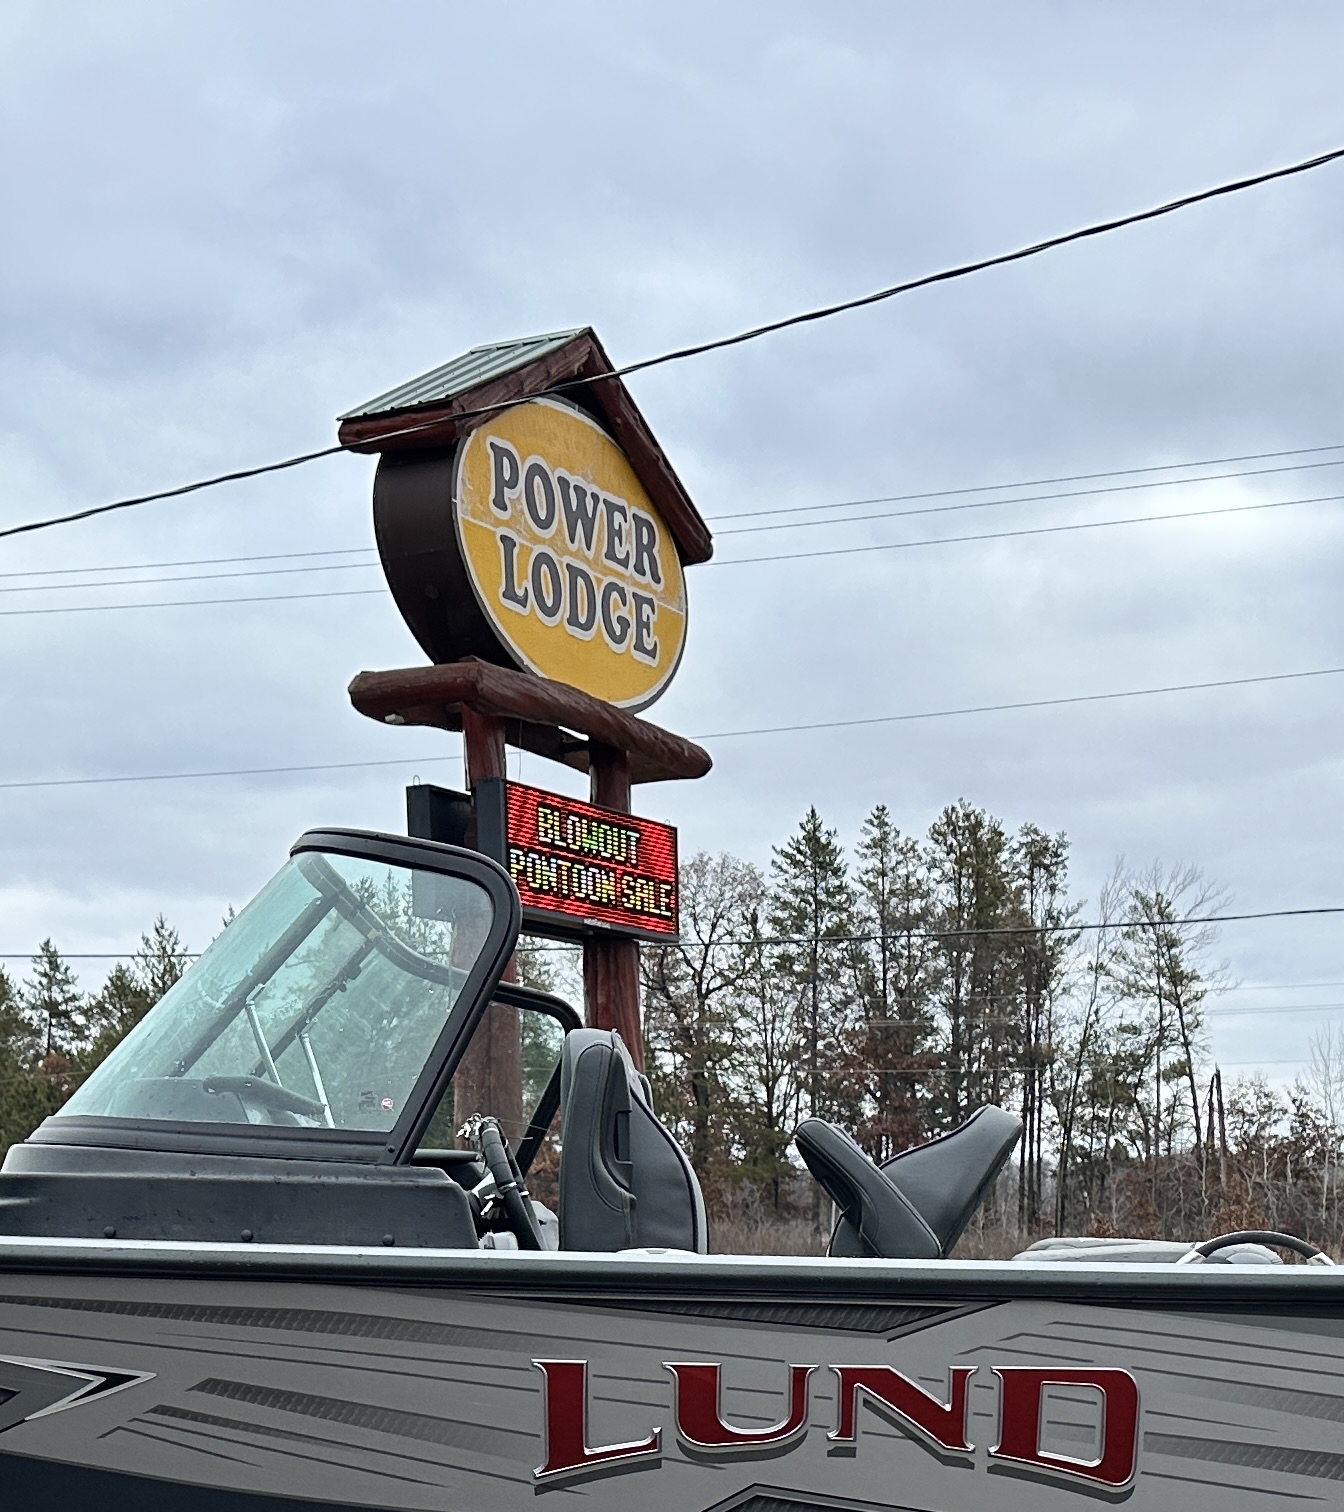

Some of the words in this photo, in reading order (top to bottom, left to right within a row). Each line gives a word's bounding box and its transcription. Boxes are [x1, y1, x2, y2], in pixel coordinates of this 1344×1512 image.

[489, 440, 662, 585] POWER
[499, 534, 658, 660] LODGE
[509, 847, 617, 905] PONTOON
[621, 874, 672, 917] SALE
[537, 806, 641, 865] BLOWOUT
[530, 1357, 1142, 1492] LUND
